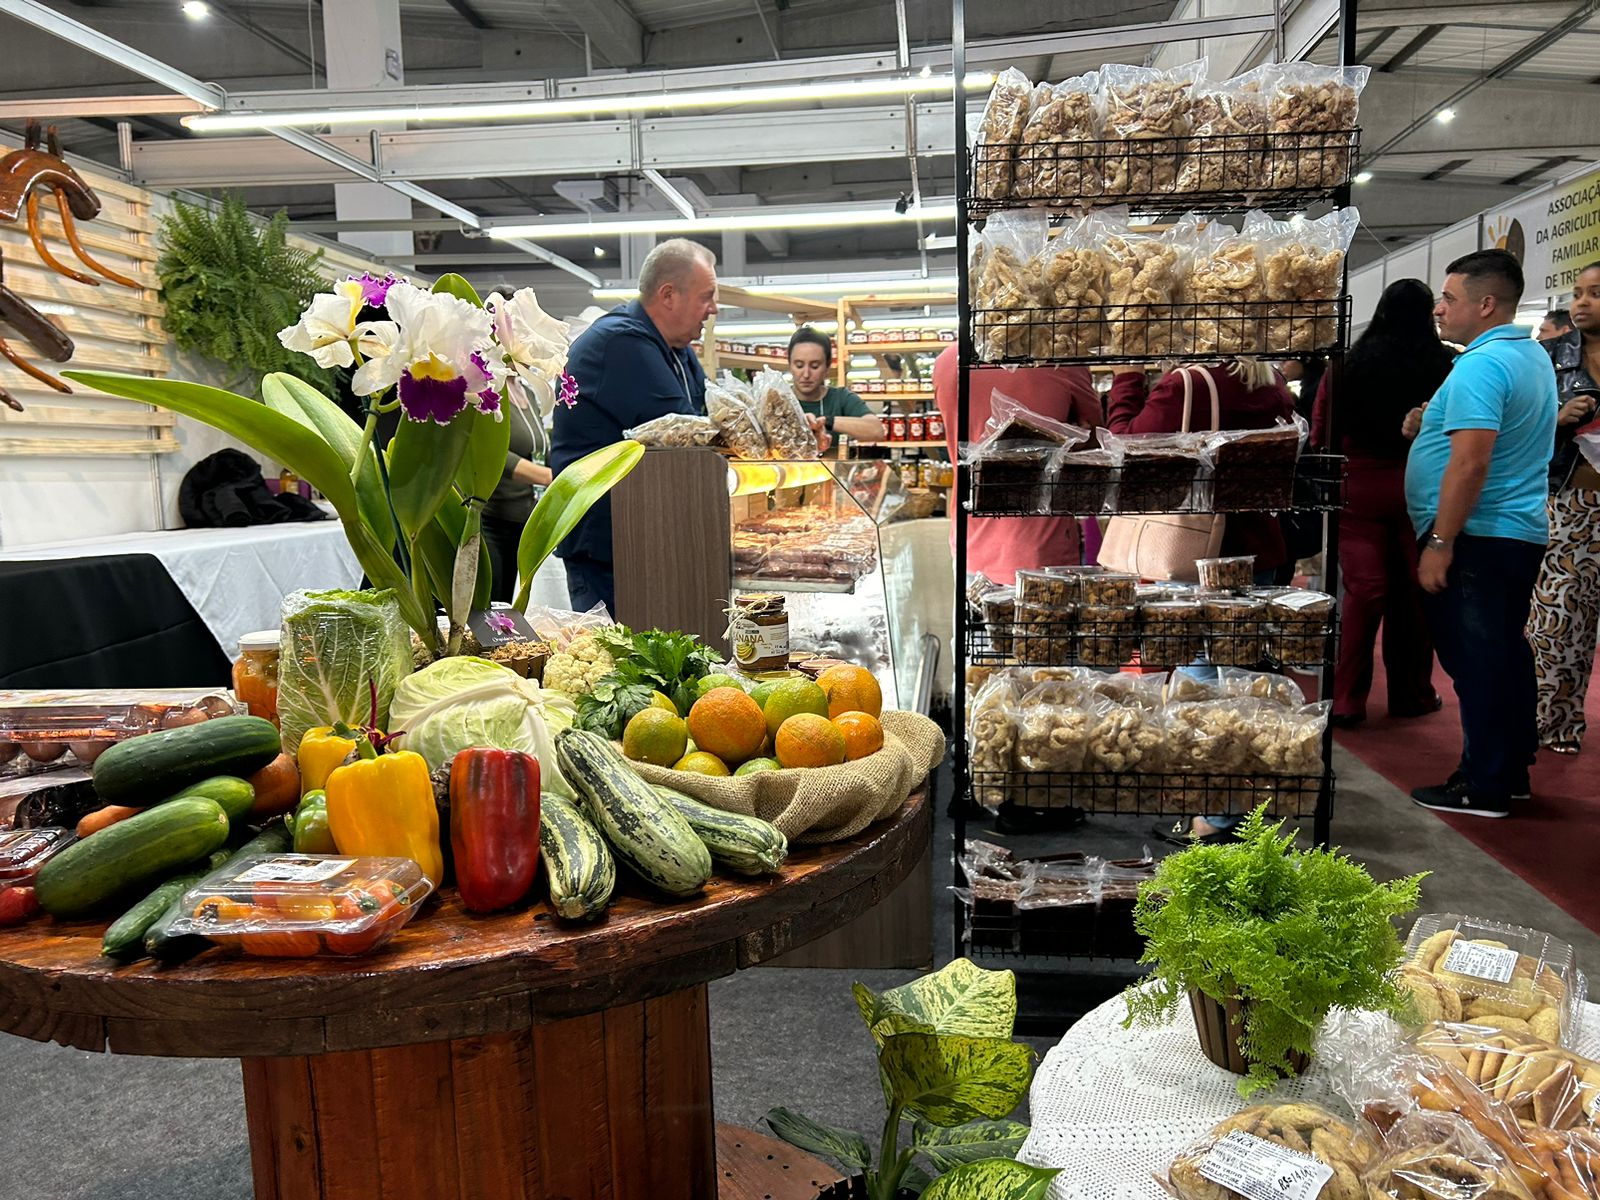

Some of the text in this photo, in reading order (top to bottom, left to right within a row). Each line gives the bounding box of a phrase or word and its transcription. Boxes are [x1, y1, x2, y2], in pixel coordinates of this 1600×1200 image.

[1536, 228, 1549, 244] DA
[1552, 236, 1599, 264] FAMILIAR
[1545, 273, 1558, 289] DE
